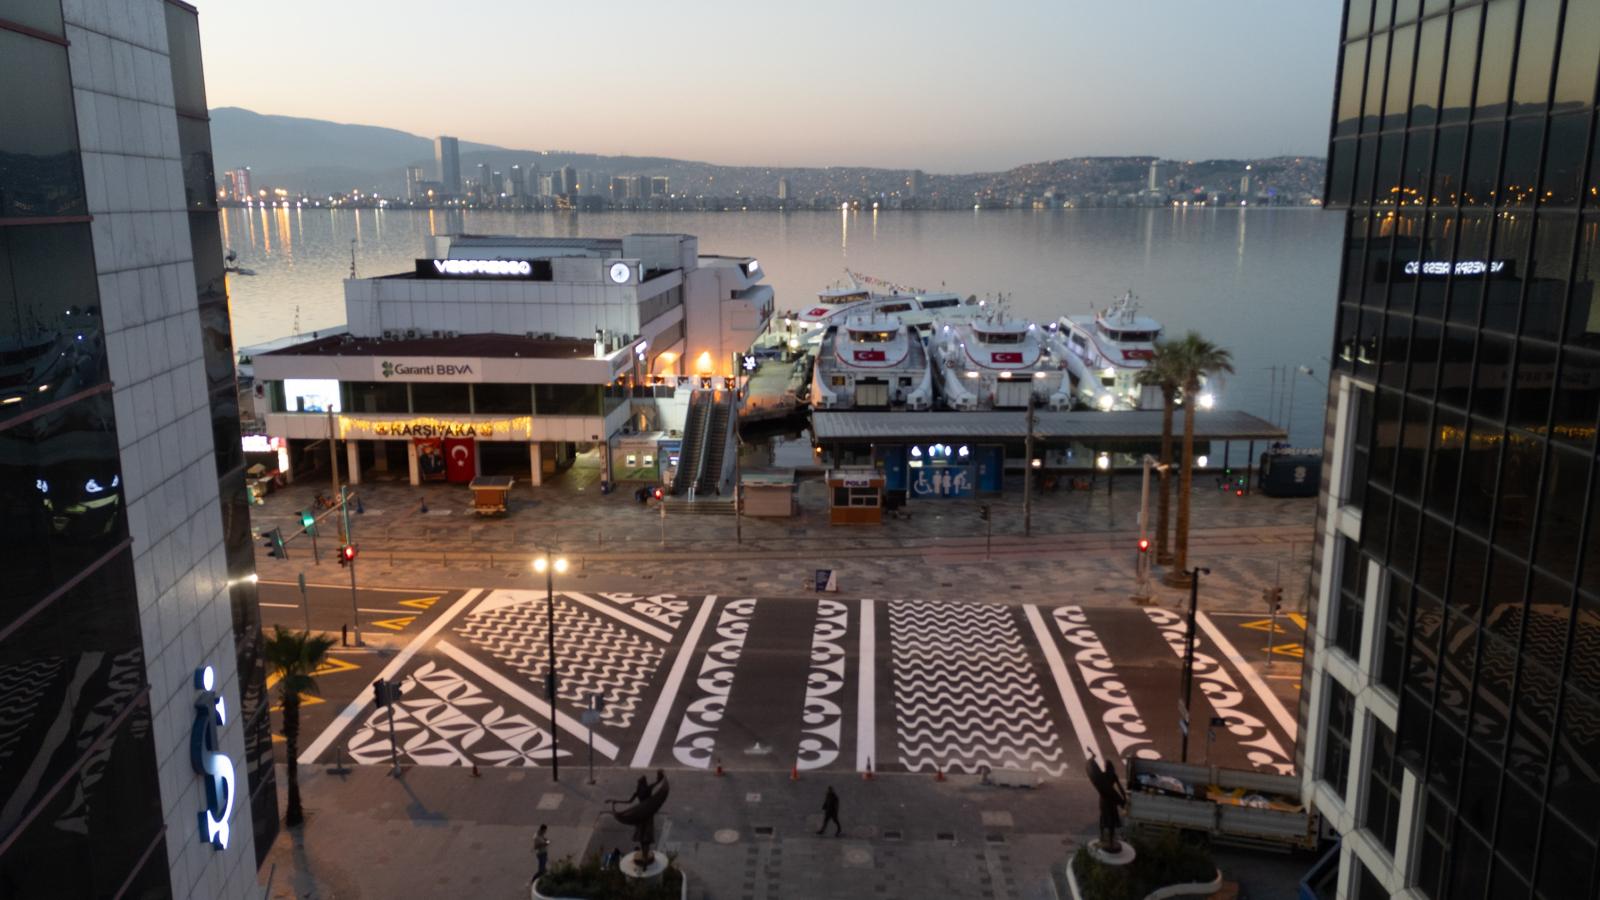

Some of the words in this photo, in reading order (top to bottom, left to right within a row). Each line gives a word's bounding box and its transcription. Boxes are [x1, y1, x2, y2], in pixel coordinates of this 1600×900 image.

[395, 363, 434, 375] Garanti
[436, 364, 473, 375] BBVA
[390, 424, 477, 438] KARŞIYAKA
